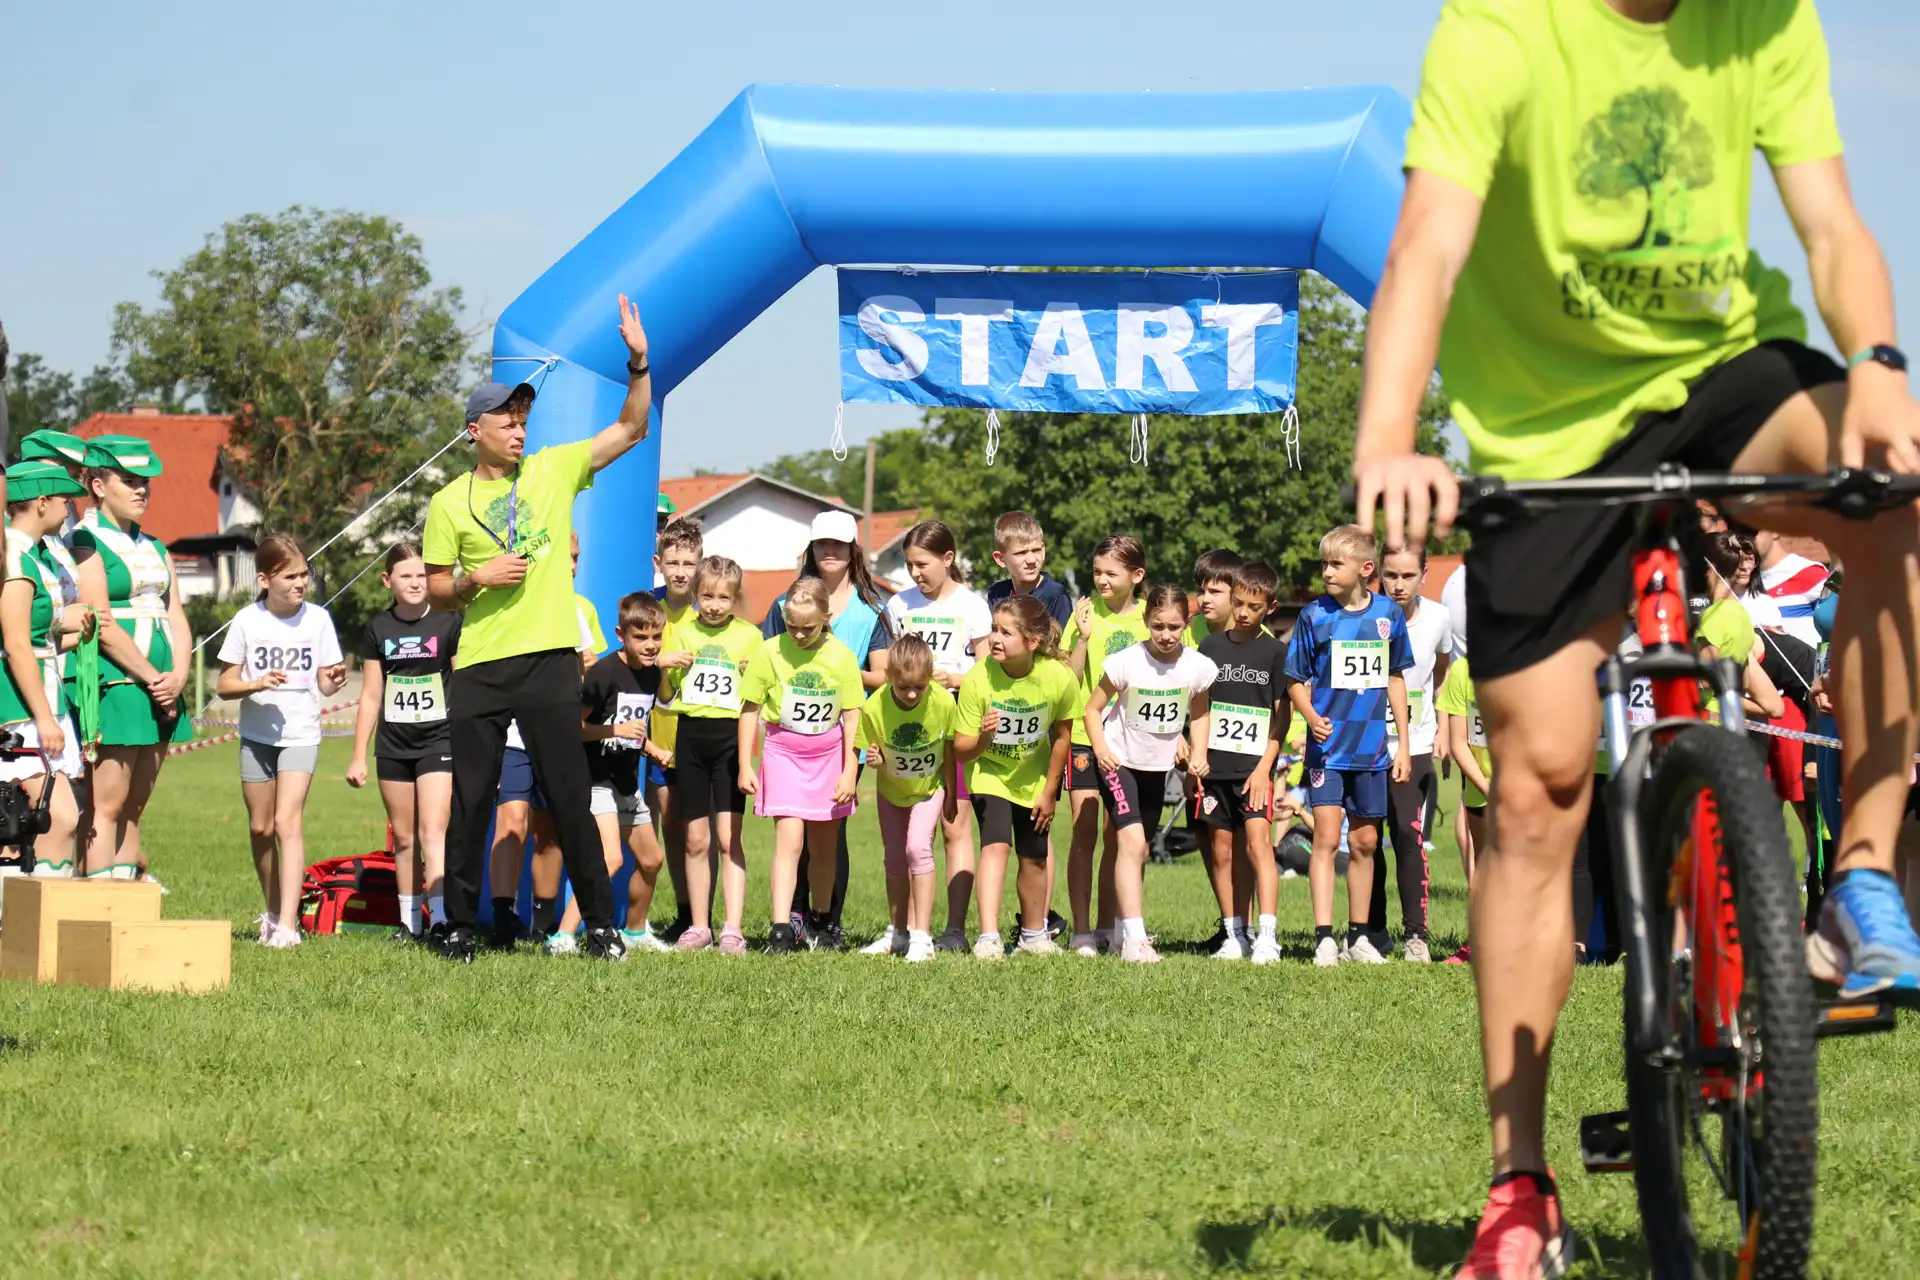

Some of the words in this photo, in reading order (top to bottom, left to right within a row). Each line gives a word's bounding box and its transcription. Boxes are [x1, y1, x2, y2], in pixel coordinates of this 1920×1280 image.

[856, 295, 1282, 392] START
[919, 630, 953, 651] 47
[254, 646, 313, 671] 3825
[1344, 655, 1382, 676] 514
[693, 672, 732, 696] 433
[1214, 663, 1270, 685] didas
[393, 690, 434, 711] 445
[791, 702, 834, 723] 522
[1138, 702, 1179, 722] 443
[996, 716, 1040, 736] 318
[1216, 717, 1258, 743] 324
[895, 752, 936, 772] 329
